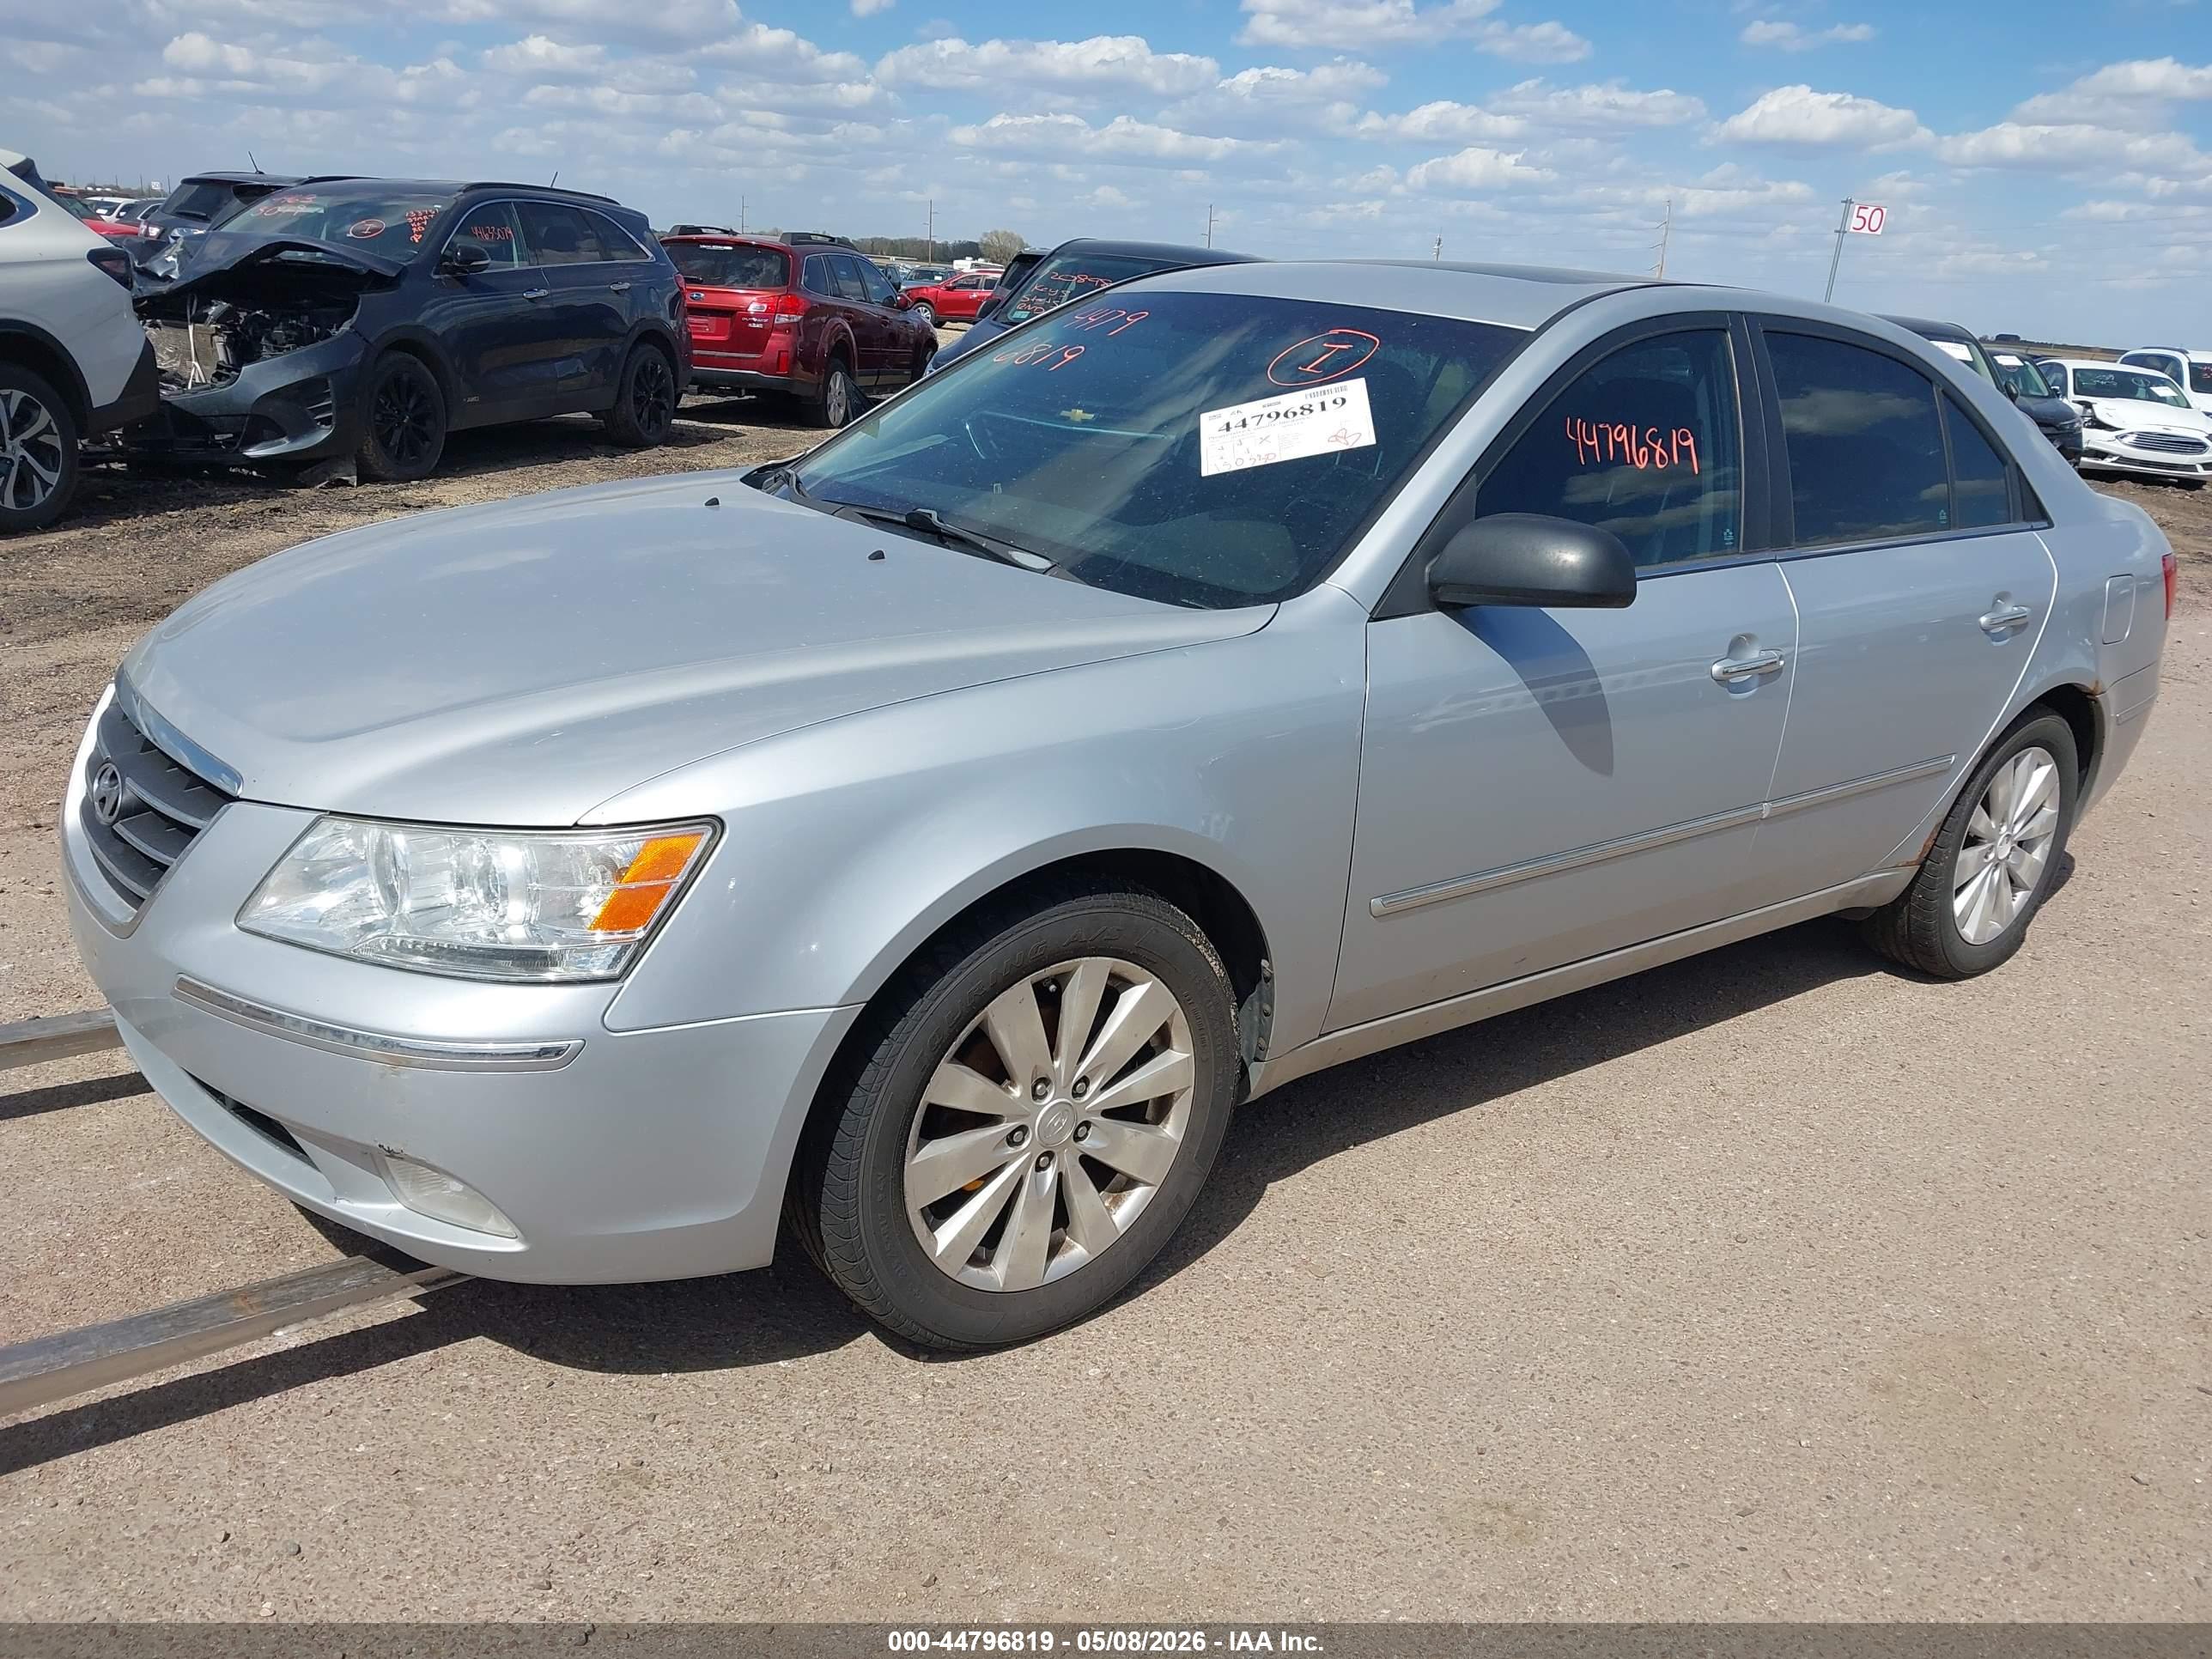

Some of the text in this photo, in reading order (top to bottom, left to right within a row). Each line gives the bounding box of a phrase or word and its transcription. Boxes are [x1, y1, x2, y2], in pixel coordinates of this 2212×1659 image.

[1852, 206, 1884, 233] 50
[1063, 308, 1150, 337] 4479
[993, 337, 1086, 372] 6819
[1218, 397, 1347, 433] 44796819
[1565, 416, 1699, 476] 44796819
